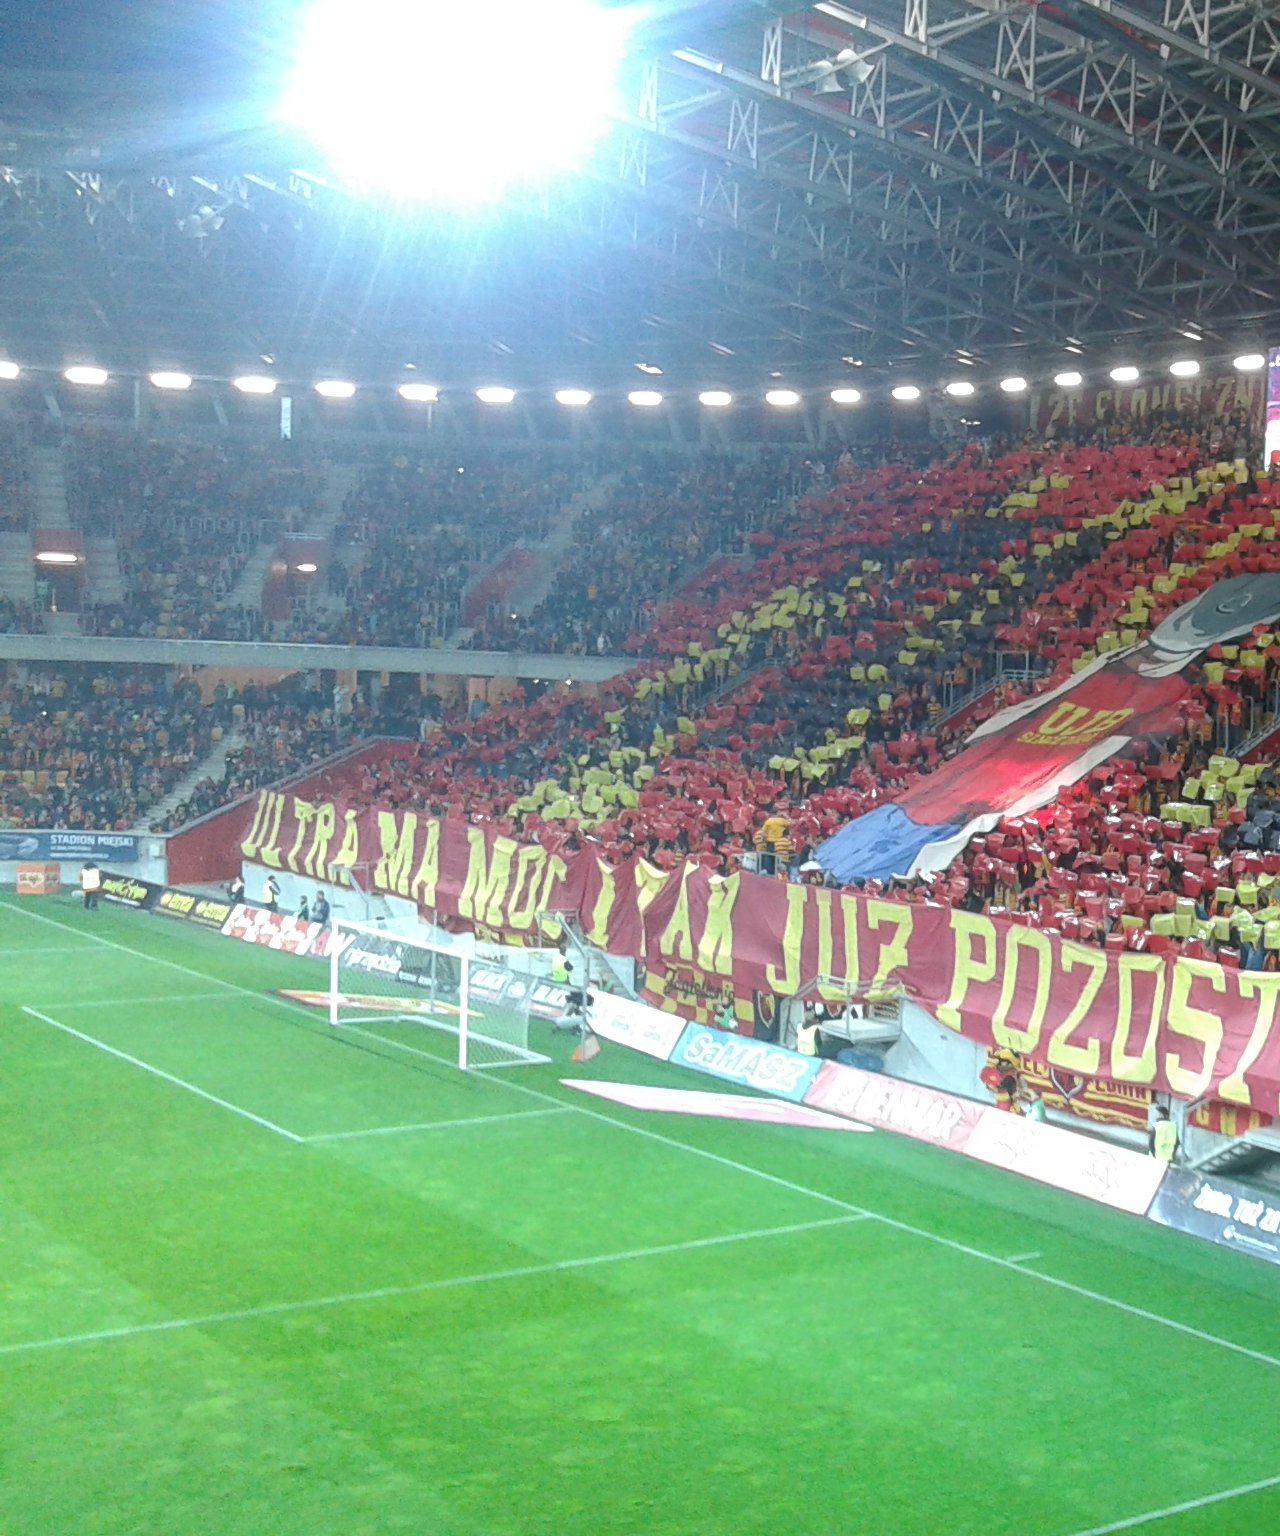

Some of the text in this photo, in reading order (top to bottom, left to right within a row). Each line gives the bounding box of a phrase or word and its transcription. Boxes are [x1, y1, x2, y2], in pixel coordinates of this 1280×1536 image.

[50, 834, 95, 846] STADION
[97, 836, 134, 848] MIEJSKI
[241, 789, 358, 886] ULTRA
[374, 811, 440, 907] MA
[635, 856, 740, 976] TAK
[685, 1033, 808, 1090] SaMASZ
